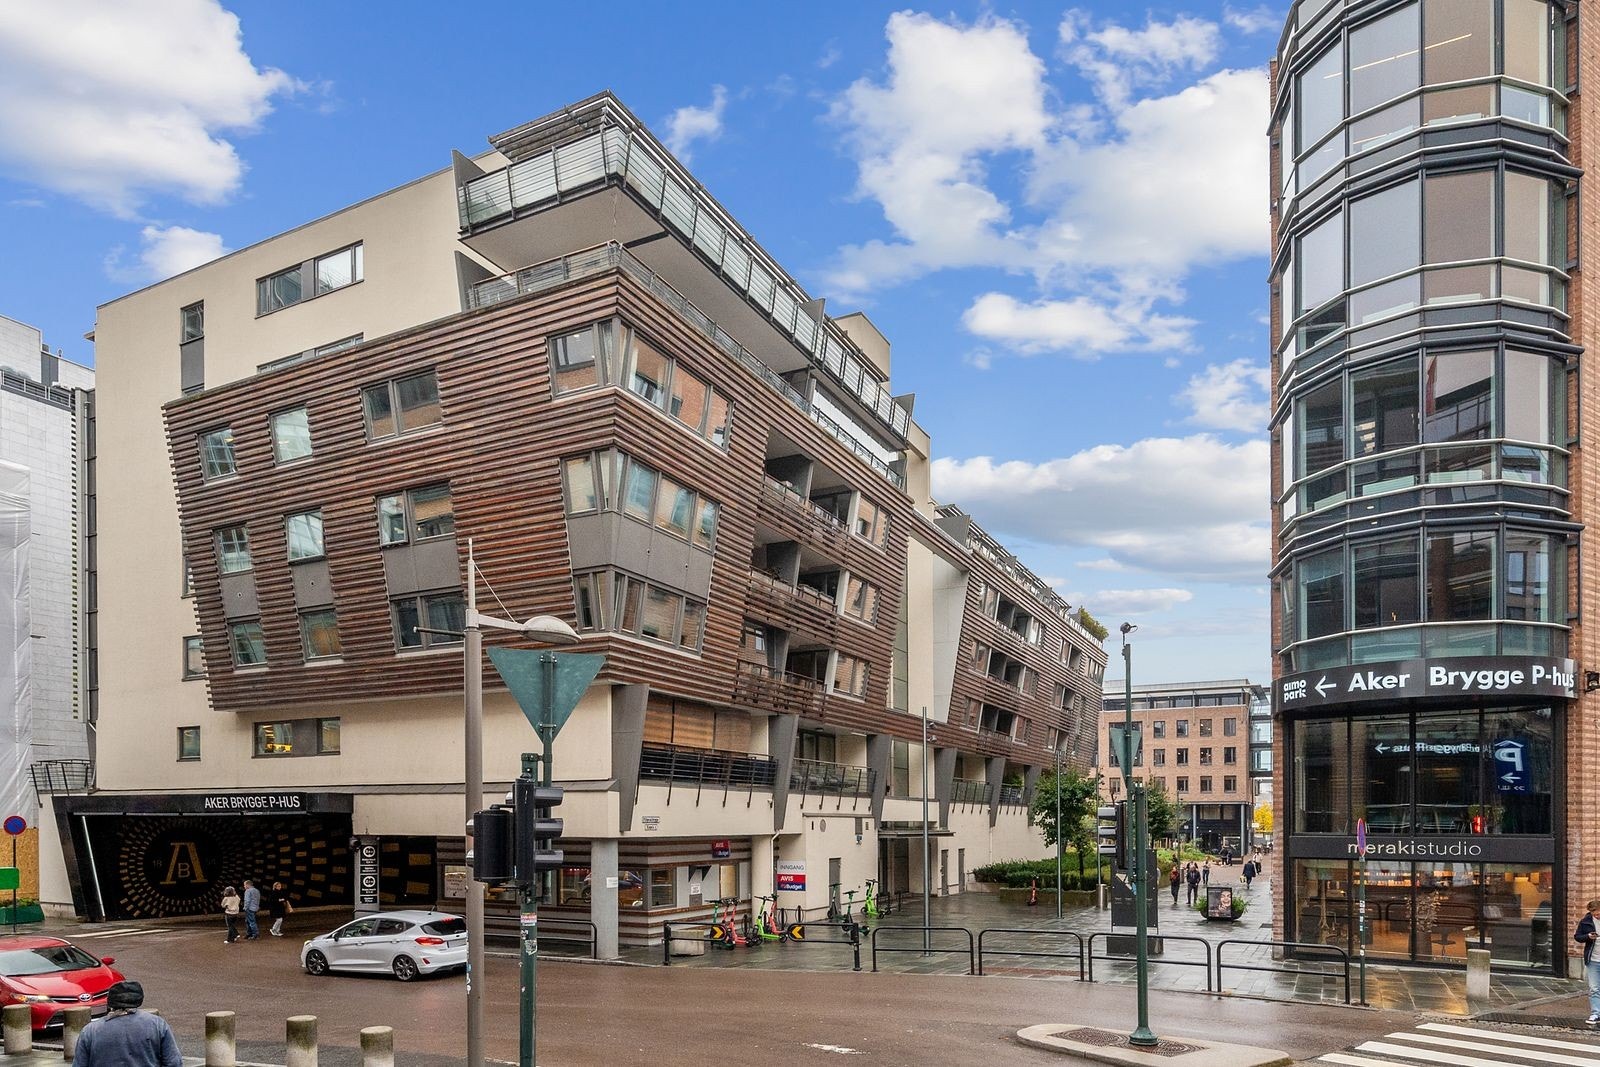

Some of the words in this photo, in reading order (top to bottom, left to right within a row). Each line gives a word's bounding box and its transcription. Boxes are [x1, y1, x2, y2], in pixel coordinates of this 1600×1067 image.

[1348, 672, 1410, 692] Aker
[1430, 666, 1524, 690] Brygge
[1532, 665, 1574, 687] P-hus
[1284, 679, 1307, 692] aimo
[1284, 690, 1307, 702] park
[205, 797, 229, 808] AKER
[230, 796, 268, 808] BRYGGE
[269, 795, 300, 807] P-HUS
[1348, 841, 1481, 855] merakistudio
